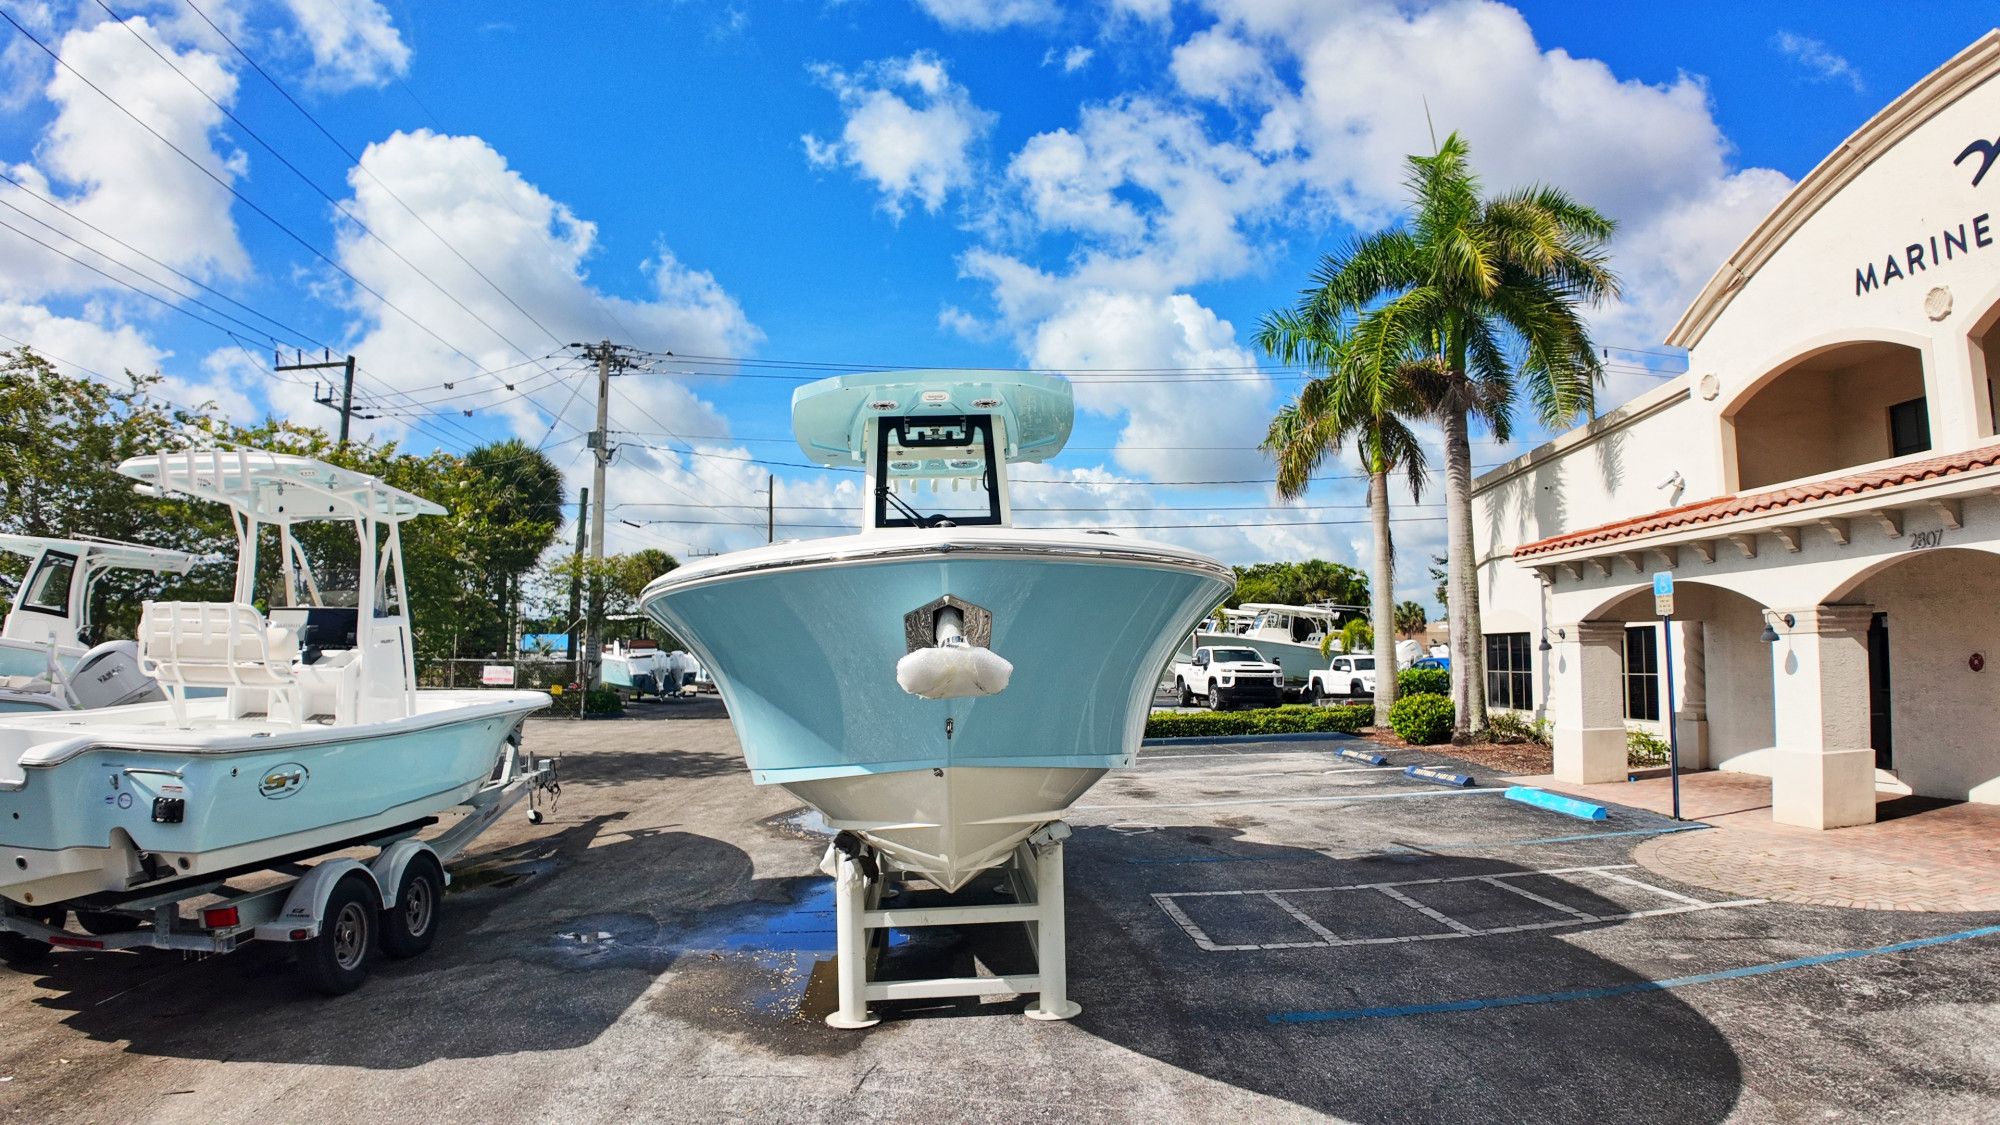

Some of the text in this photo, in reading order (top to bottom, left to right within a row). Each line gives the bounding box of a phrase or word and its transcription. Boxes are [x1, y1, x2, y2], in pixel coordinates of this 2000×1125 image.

[1855, 212, 1994, 297] MARINE
[1910, 528, 1944, 550] 2807
[97, 663, 128, 684] YAMA
